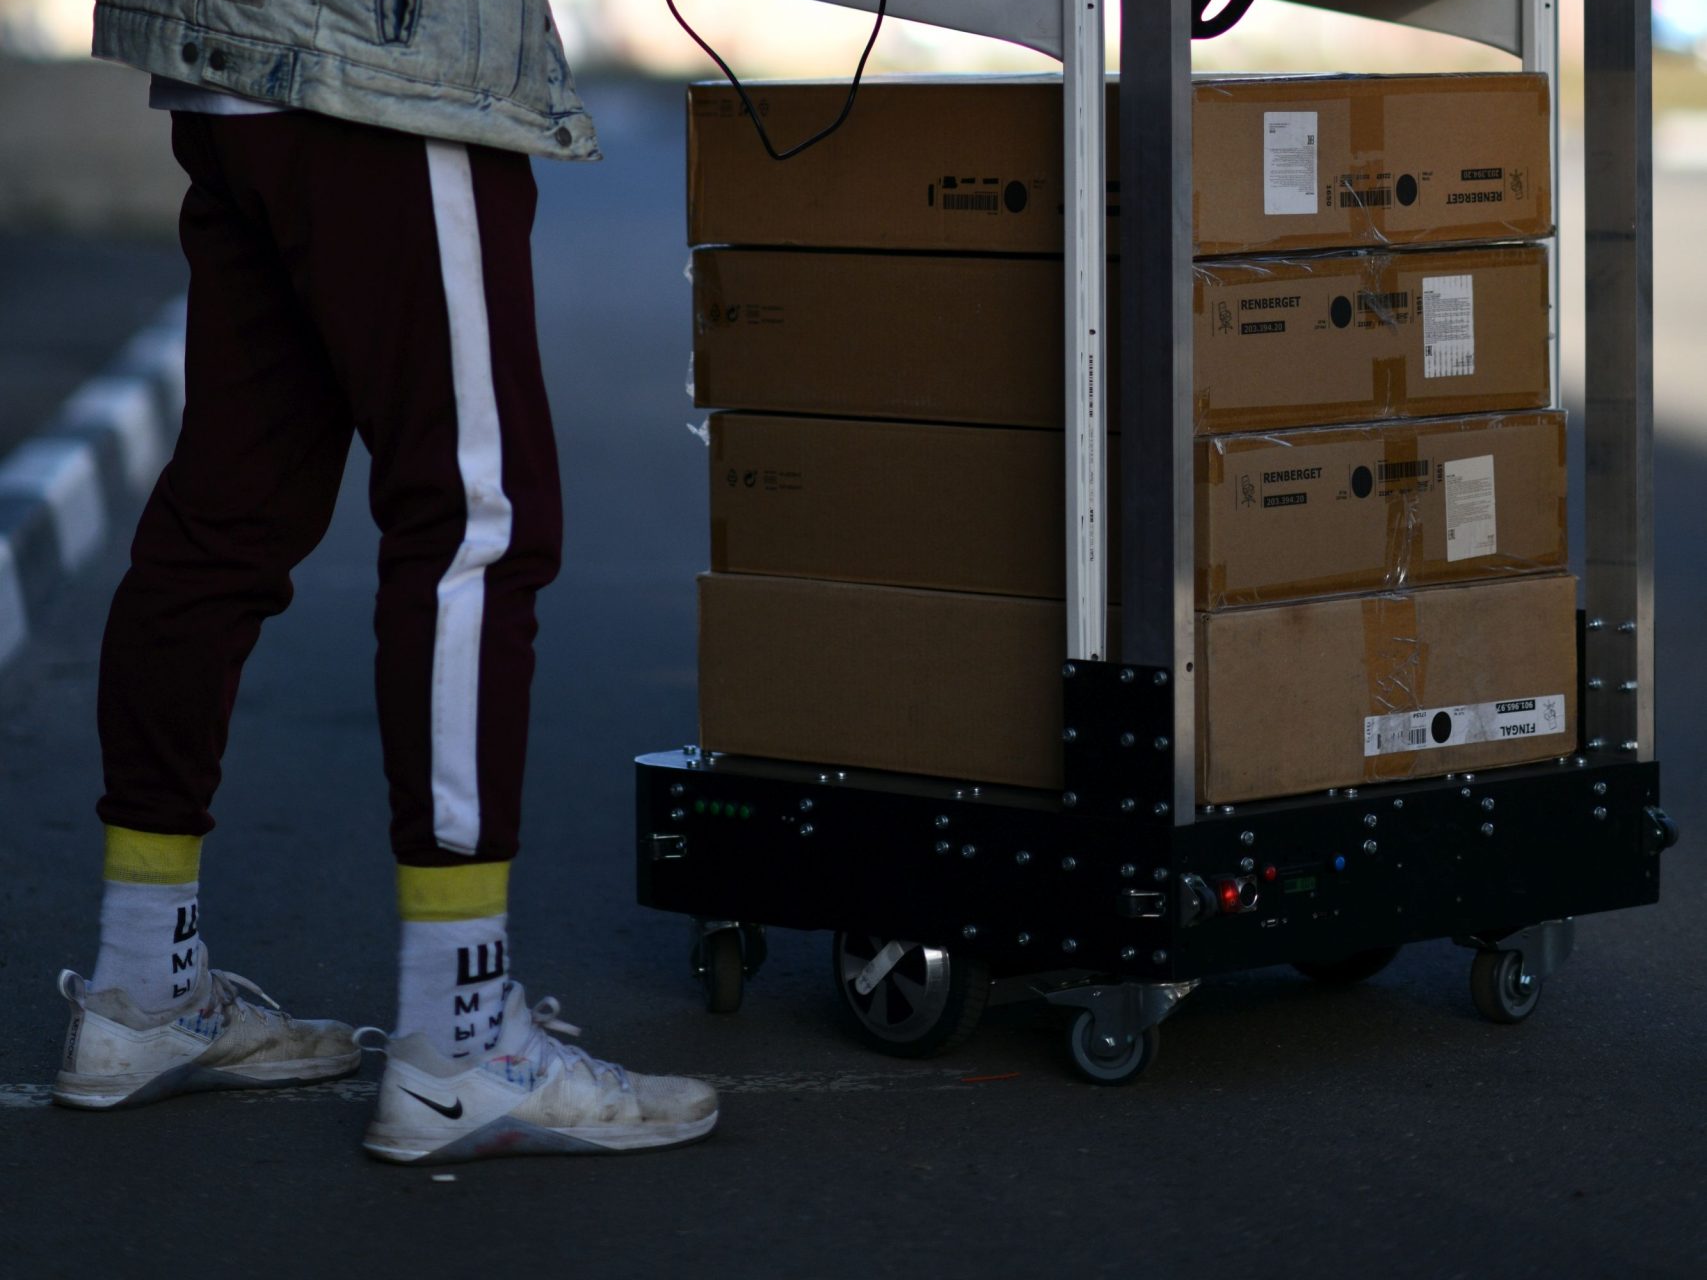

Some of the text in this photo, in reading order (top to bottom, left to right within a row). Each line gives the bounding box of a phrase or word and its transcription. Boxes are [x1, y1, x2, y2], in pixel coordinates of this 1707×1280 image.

[1446, 191, 1502, 205] RENBERGET
[1241, 296, 1301, 310] RENBERGET
[1263, 467, 1322, 483] RENBERGET
[1496, 700, 1534, 713] 901.965.97
[1499, 723, 1536, 736] FINGAL
